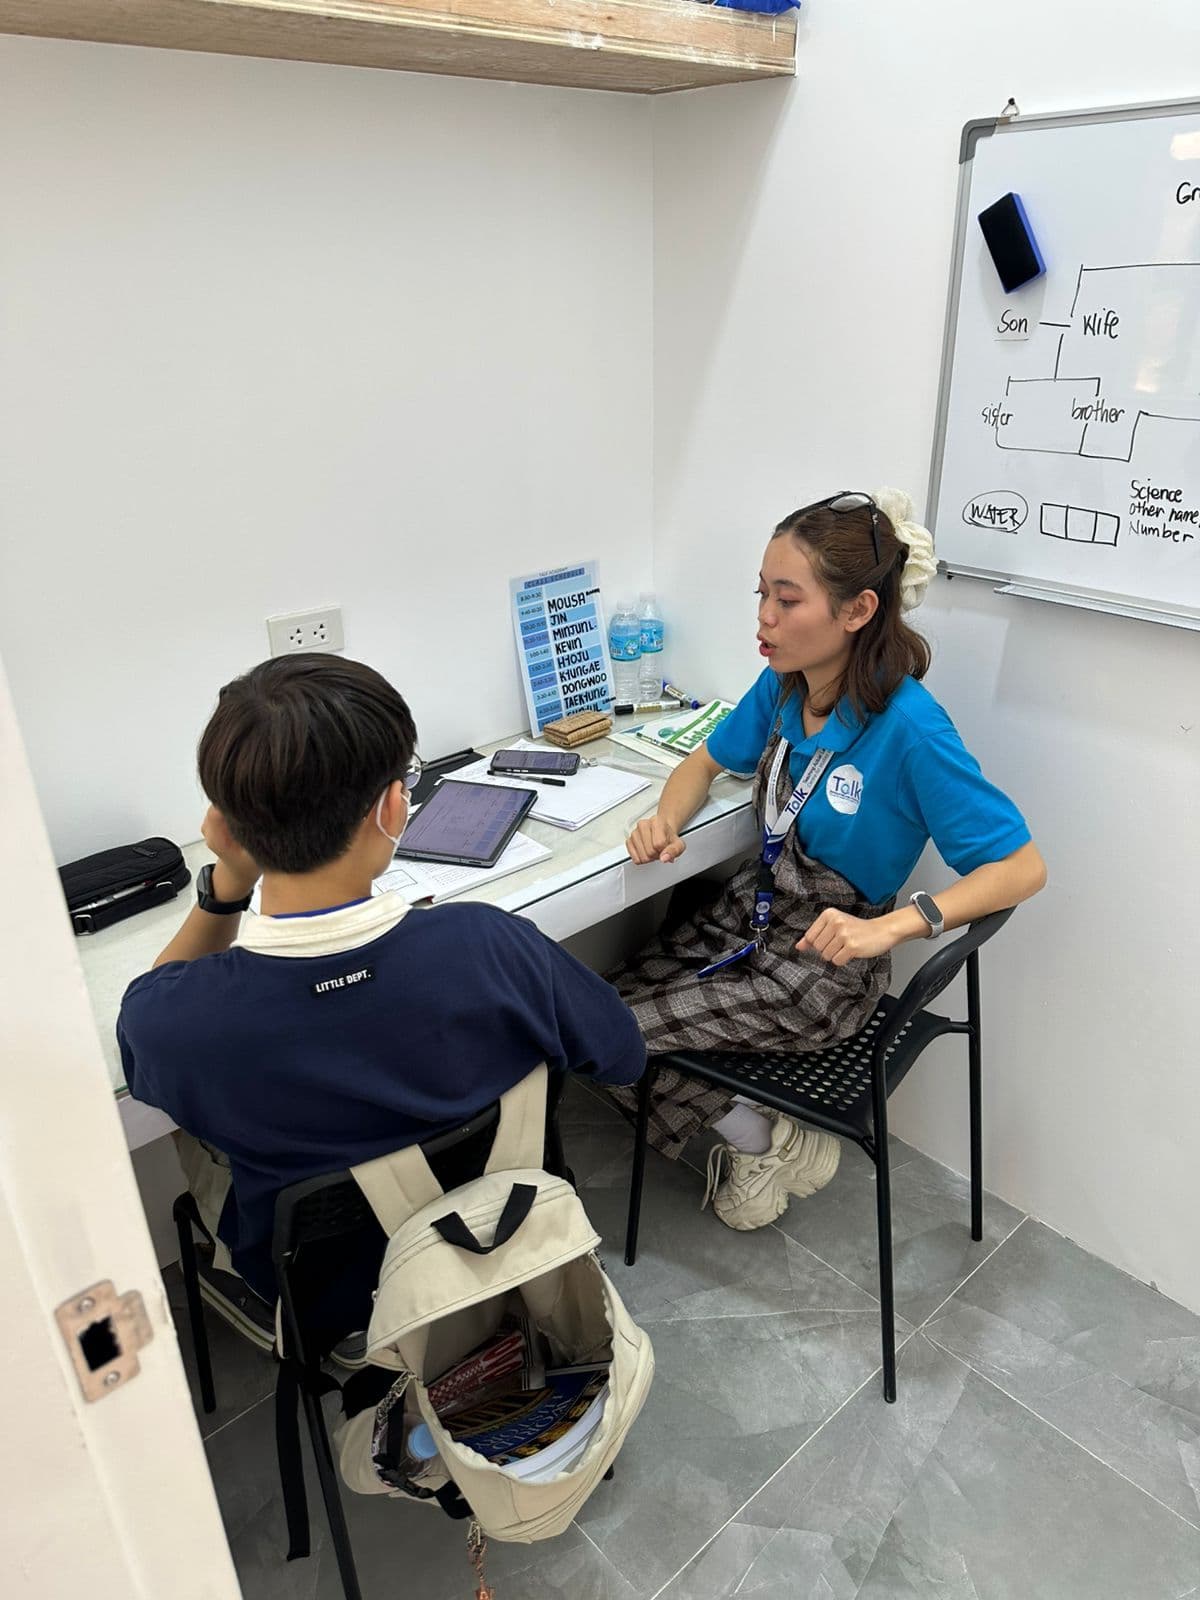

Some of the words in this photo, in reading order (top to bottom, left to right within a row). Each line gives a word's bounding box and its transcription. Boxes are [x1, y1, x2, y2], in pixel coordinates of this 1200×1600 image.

[997, 309, 1028, 333] Son
[1072, 398, 1125, 423] brother
[1129, 478, 1183, 503] Science
[970, 503, 1020, 527] WATER
[1129, 519, 1194, 543] Number
[547, 591, 586, 614] MOUSA
[549, 612, 568, 626] JIN
[555, 637, 582, 655] KEVIN
[557, 650, 590, 670] HYOJU
[559, 660, 600, 683] KYUNGAE
[562, 672, 608, 696] DONGWOO
[564, 687, 607, 710] TAEKYUNG
[833, 775, 862, 801] Talk
[785, 788, 808, 815] Talk
[315, 977, 345, 993] LITTLE
[346, 969, 372, 984] DEPT.
